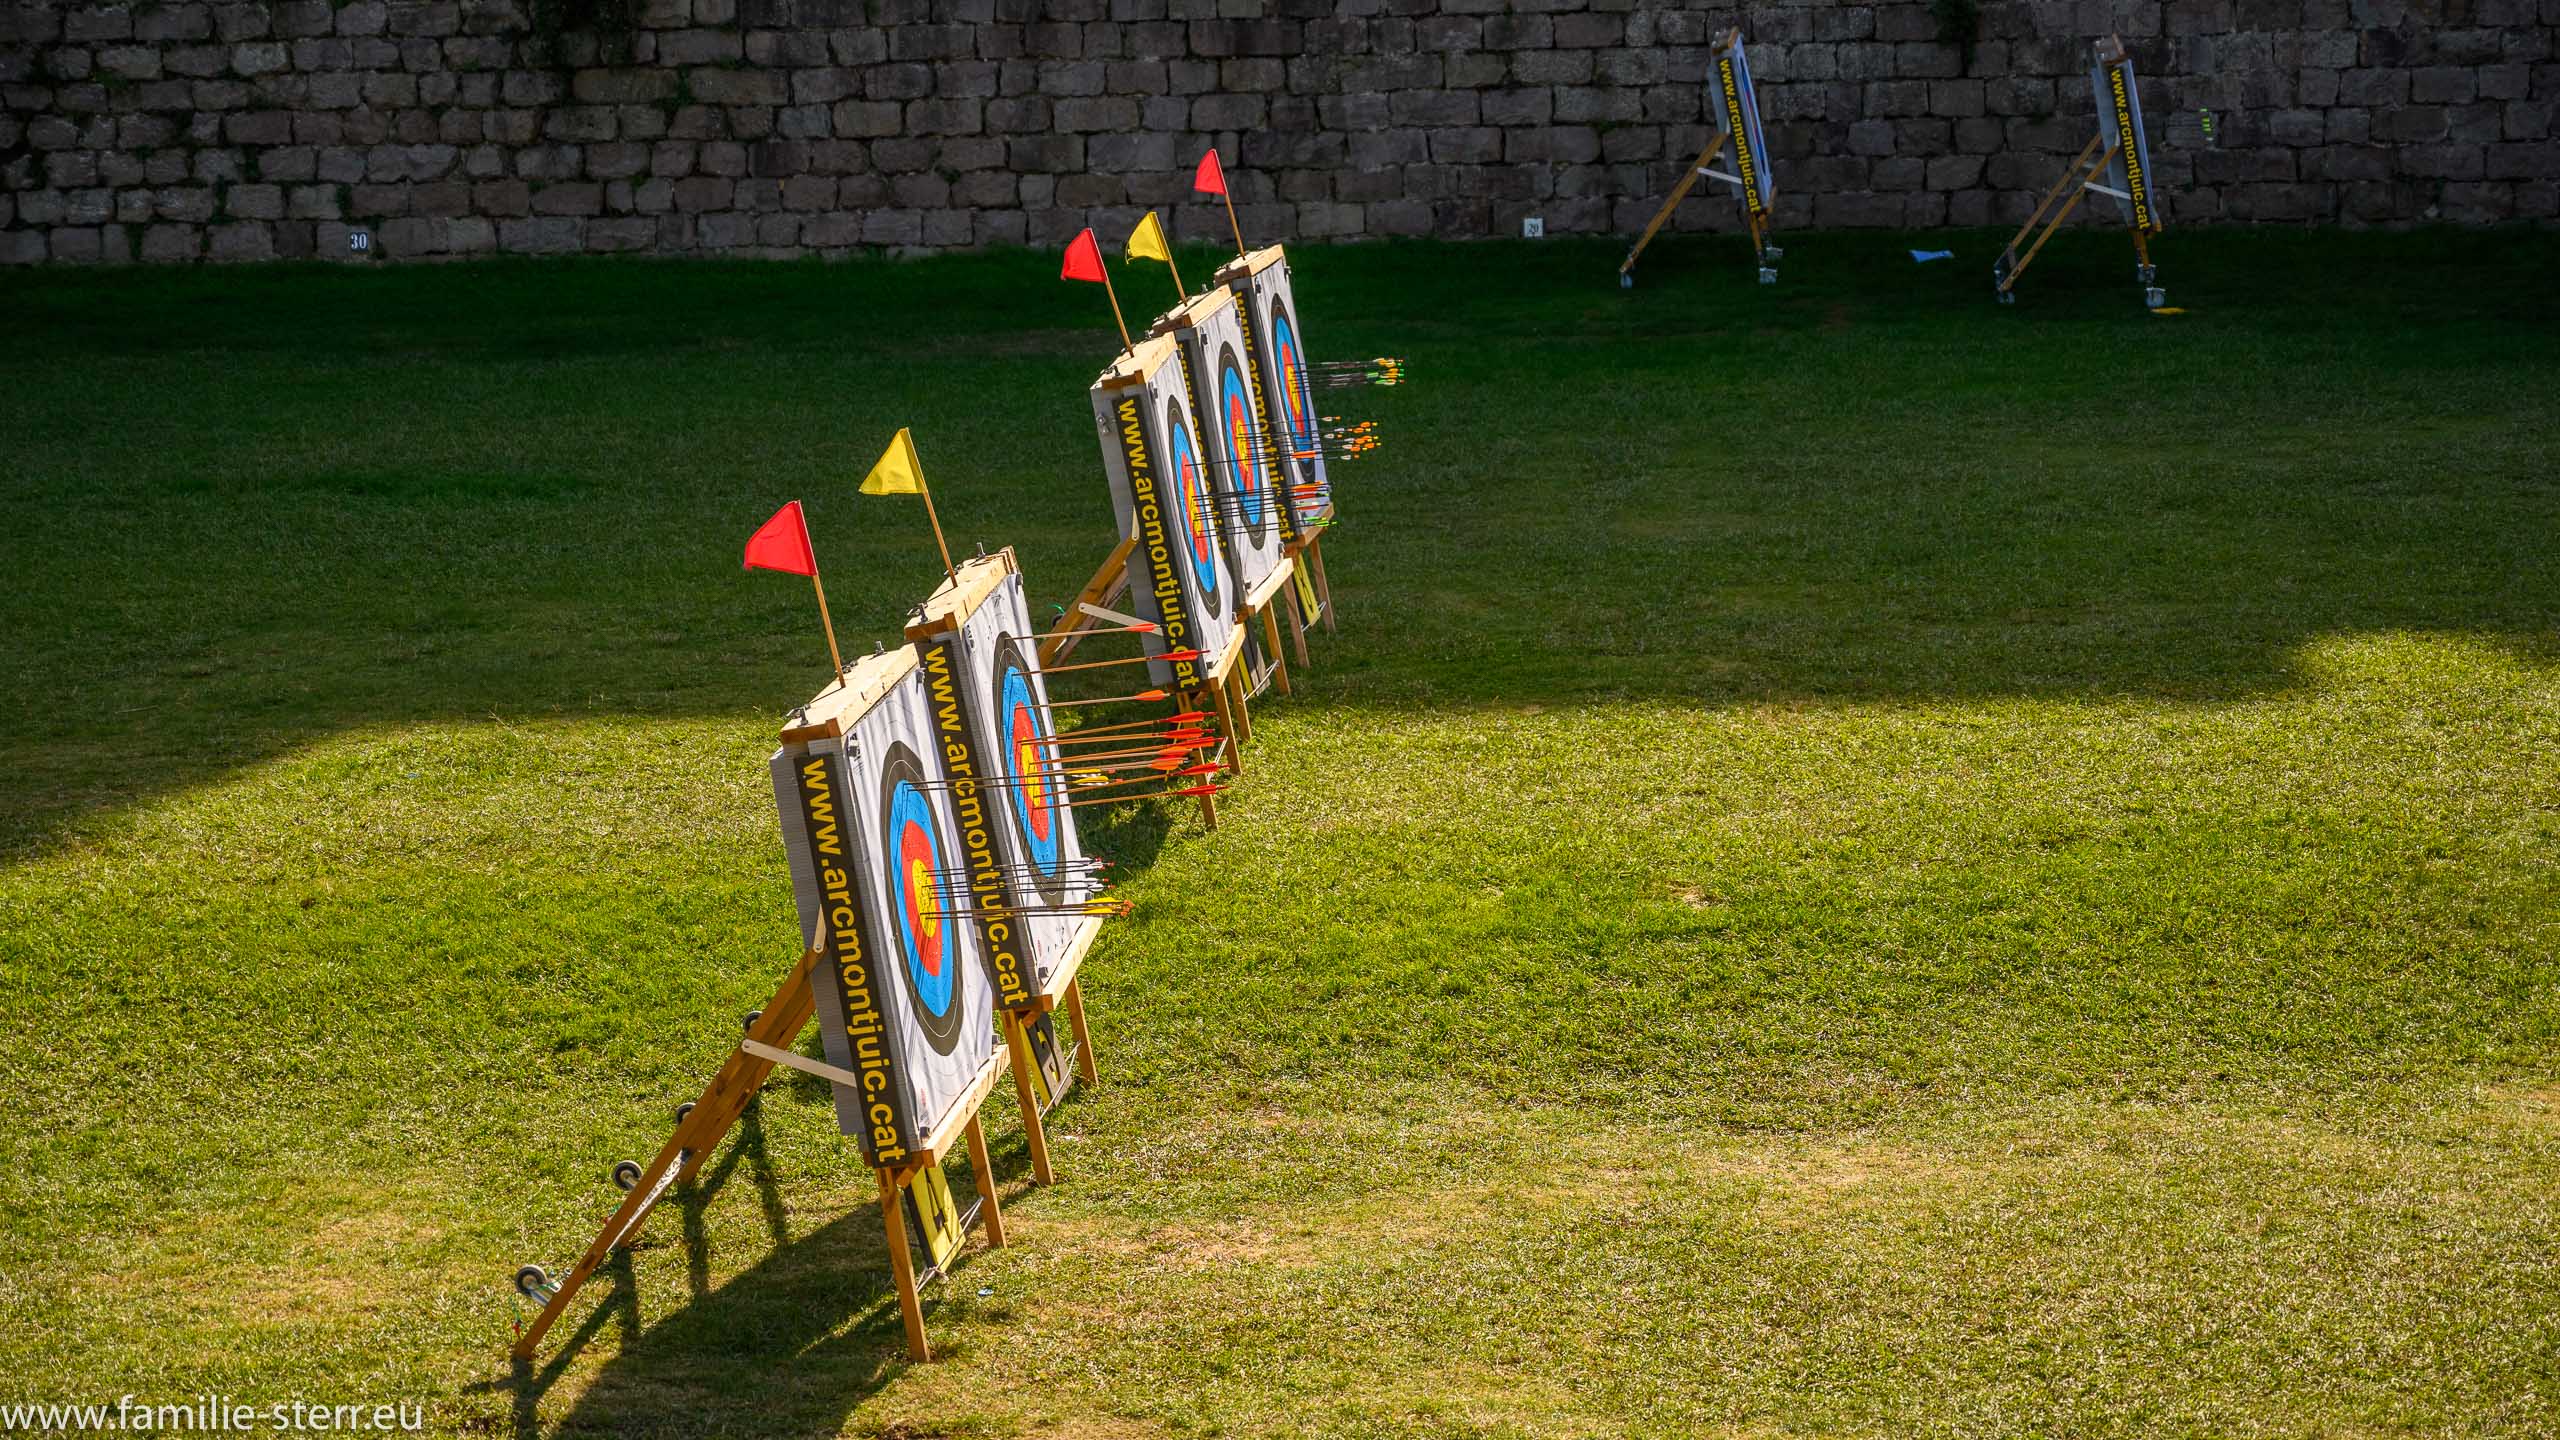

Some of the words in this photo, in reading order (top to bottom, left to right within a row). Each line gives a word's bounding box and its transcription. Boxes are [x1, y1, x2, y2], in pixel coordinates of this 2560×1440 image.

[1720, 58, 1761, 214] www.arcmontjuic.cat
[2110, 70, 2151, 229] www.arcmontjuic.cat
[351, 233, 367, 249] 30
[923, 646, 1028, 1006] www.arcmontjuic.cat
[802, 759, 906, 1163] www.arcmontjuic.cat
